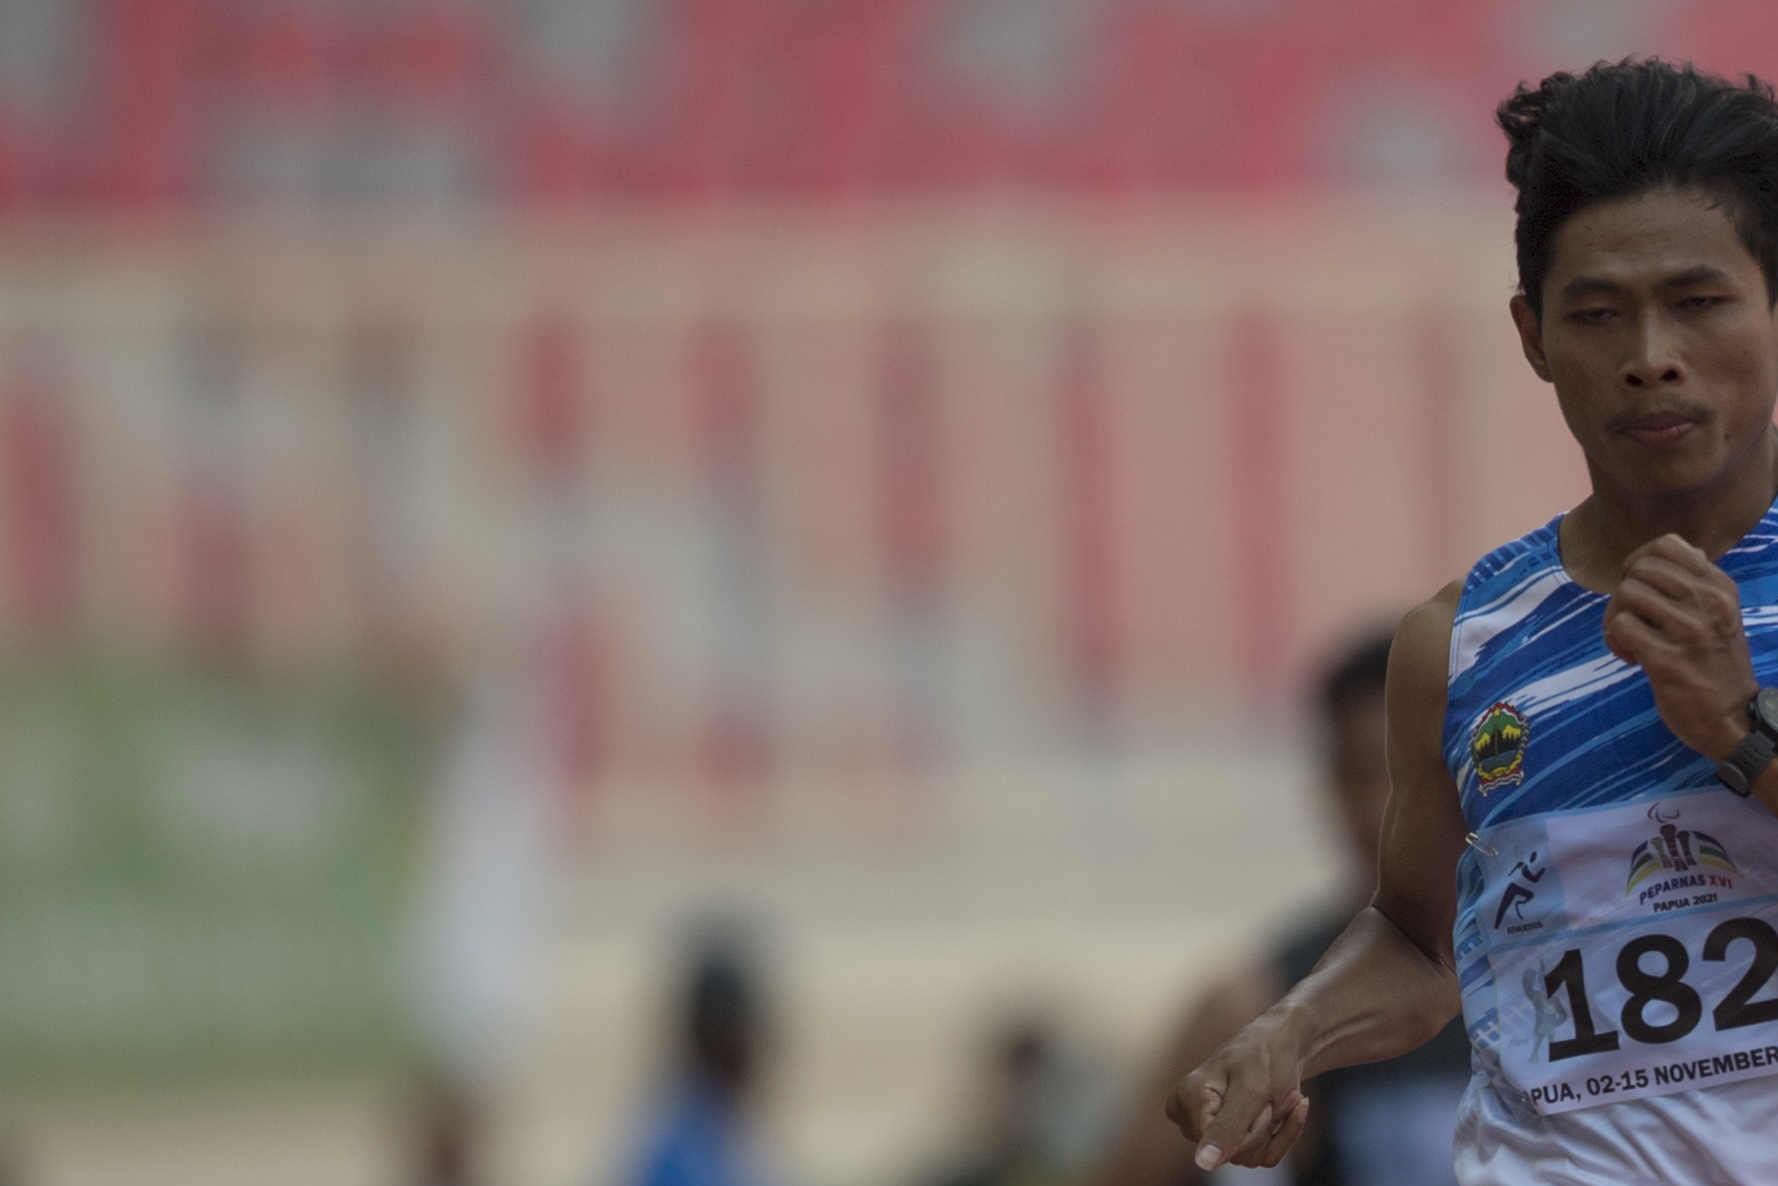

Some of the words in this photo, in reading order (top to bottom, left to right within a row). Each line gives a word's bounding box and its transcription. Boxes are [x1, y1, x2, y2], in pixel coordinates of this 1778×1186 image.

[1639, 874, 1706, 905] PEPARNAS
[1707, 874, 1733, 890] XVI
[1653, 897, 1691, 913] PAPUA
[1692, 892, 1718, 906] 2021
[1523, 1081, 1582, 1107] PUA,
[1585, 1068, 1649, 1097] 02-15
